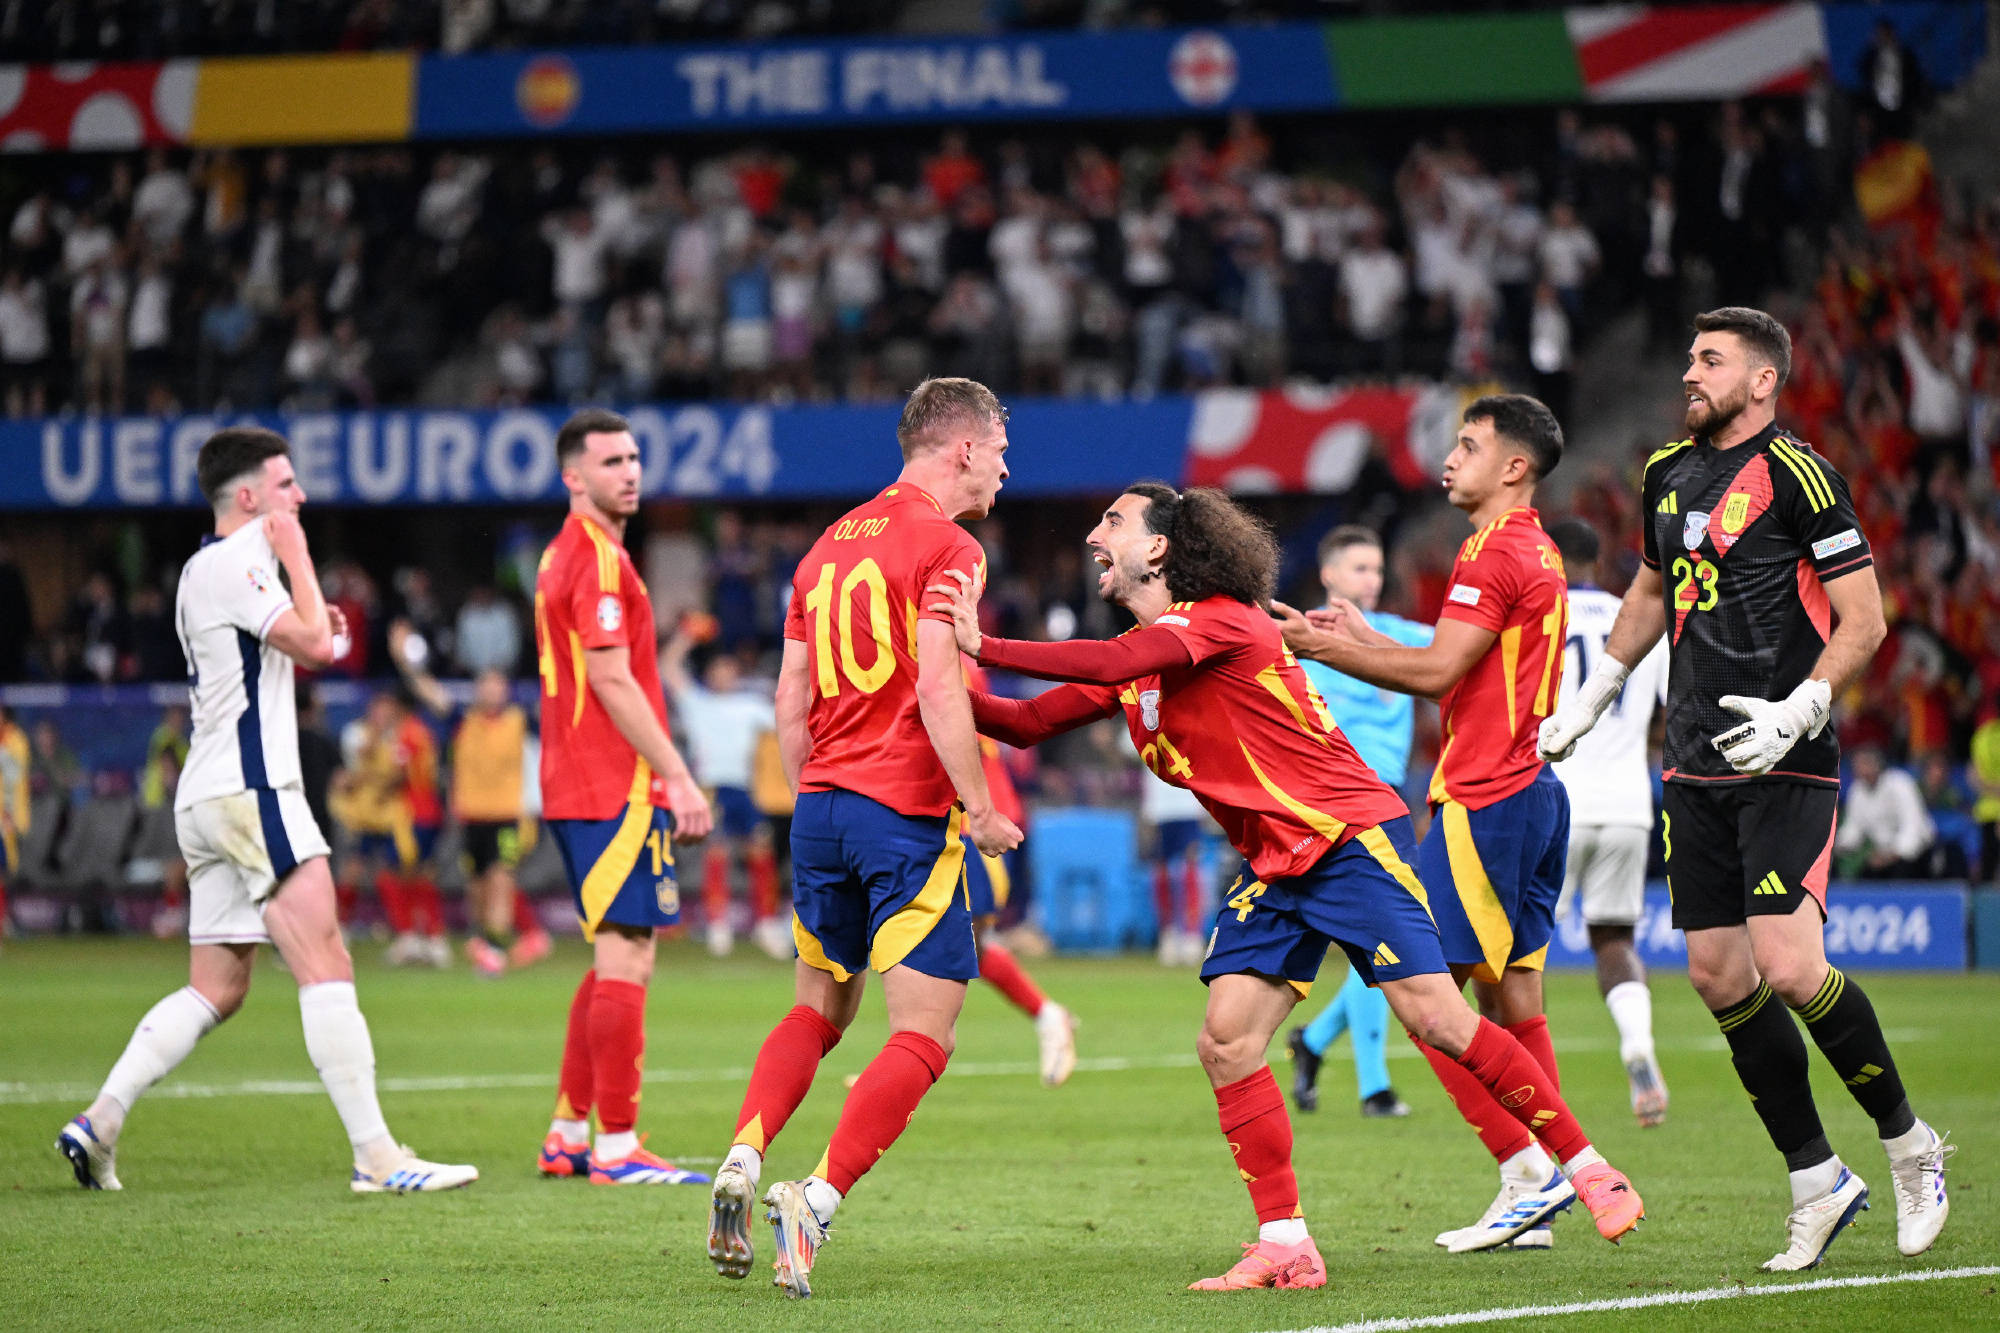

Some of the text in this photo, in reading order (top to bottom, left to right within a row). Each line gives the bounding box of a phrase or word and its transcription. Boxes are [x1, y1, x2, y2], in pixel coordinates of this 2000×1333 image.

[680, 46, 1066, 114] THE FINAL
[42, 406, 778, 506] UEF EURO 024
[834, 517, 890, 541] OLMO
[1672, 557, 1719, 611] 23
[806, 557, 897, 699] 10
[1717, 725, 1756, 750] reusch
[1826, 904, 1930, 954] 2024
